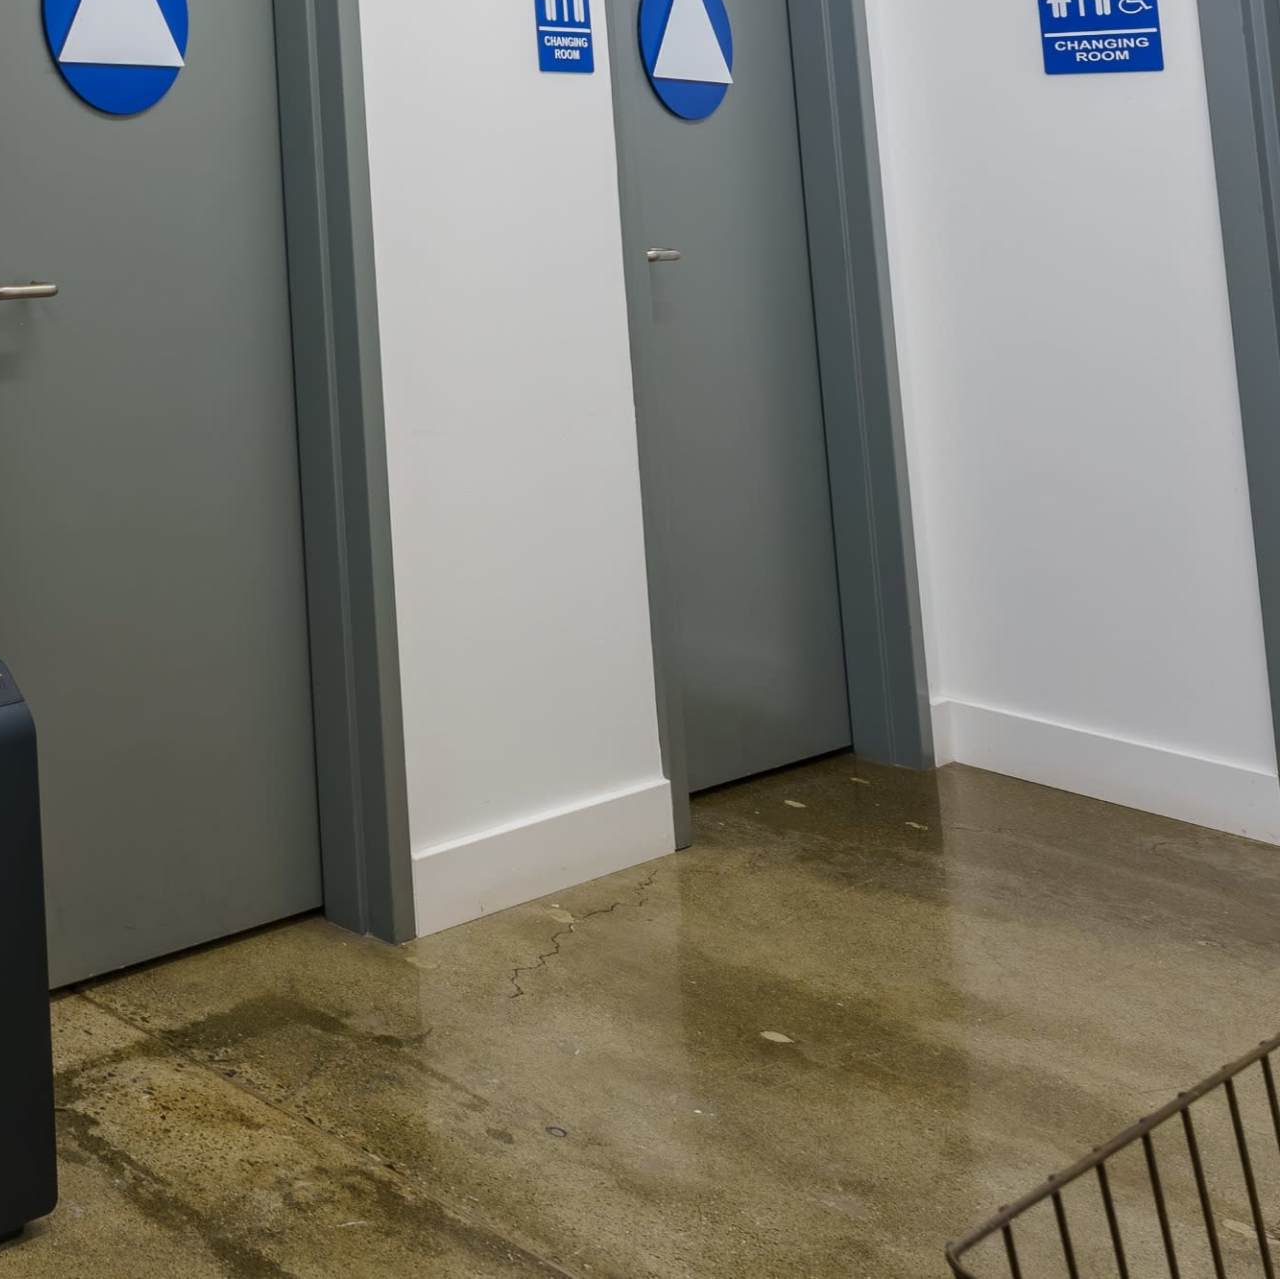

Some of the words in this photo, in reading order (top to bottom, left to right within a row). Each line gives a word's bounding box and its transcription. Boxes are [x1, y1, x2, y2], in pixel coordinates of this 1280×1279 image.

[544, 35, 589, 48] CHANGING
[1054, 37, 1150, 51] CHANGING
[554, 48, 581, 60] ROOM
[1075, 50, 1130, 62] ROOM
